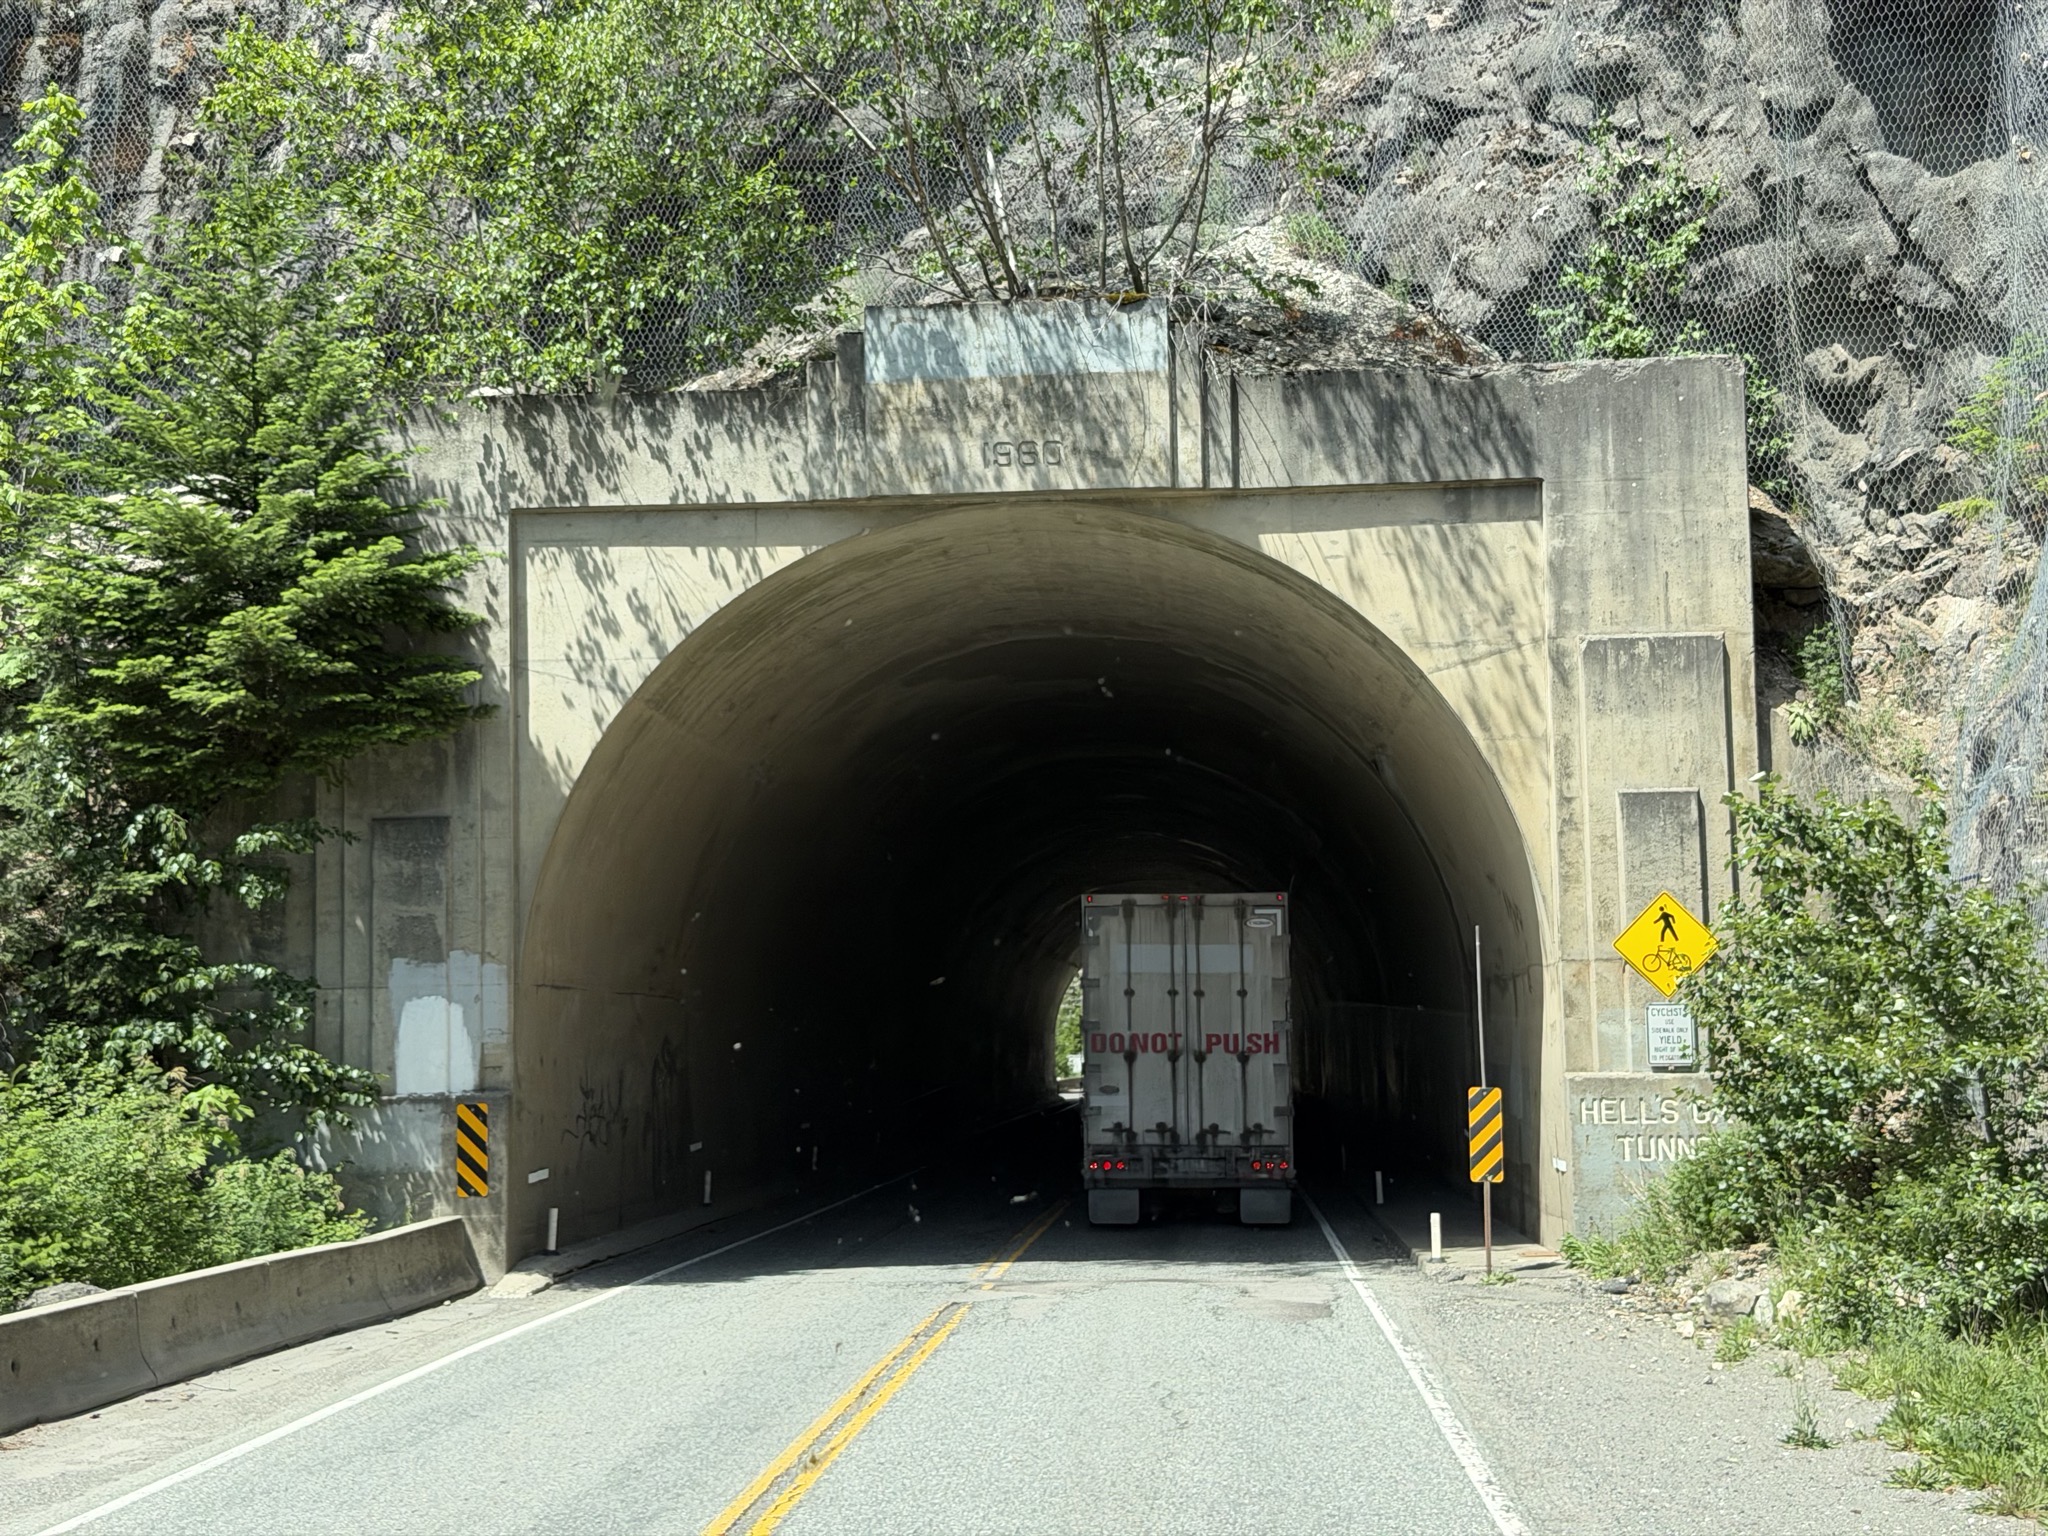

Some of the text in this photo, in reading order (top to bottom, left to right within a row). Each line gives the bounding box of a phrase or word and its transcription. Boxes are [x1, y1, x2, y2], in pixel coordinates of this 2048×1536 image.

[983, 440, 1063, 469] 1960
[1651, 1008, 1688, 1017] CYCLIST
[1091, 1032, 1280, 1054] DO NOT PUSH
[1659, 1036, 1682, 1044] YIELD
[1580, 1096, 1680, 1125] HELL'S
[1617, 1135, 1711, 1162] TUNN
